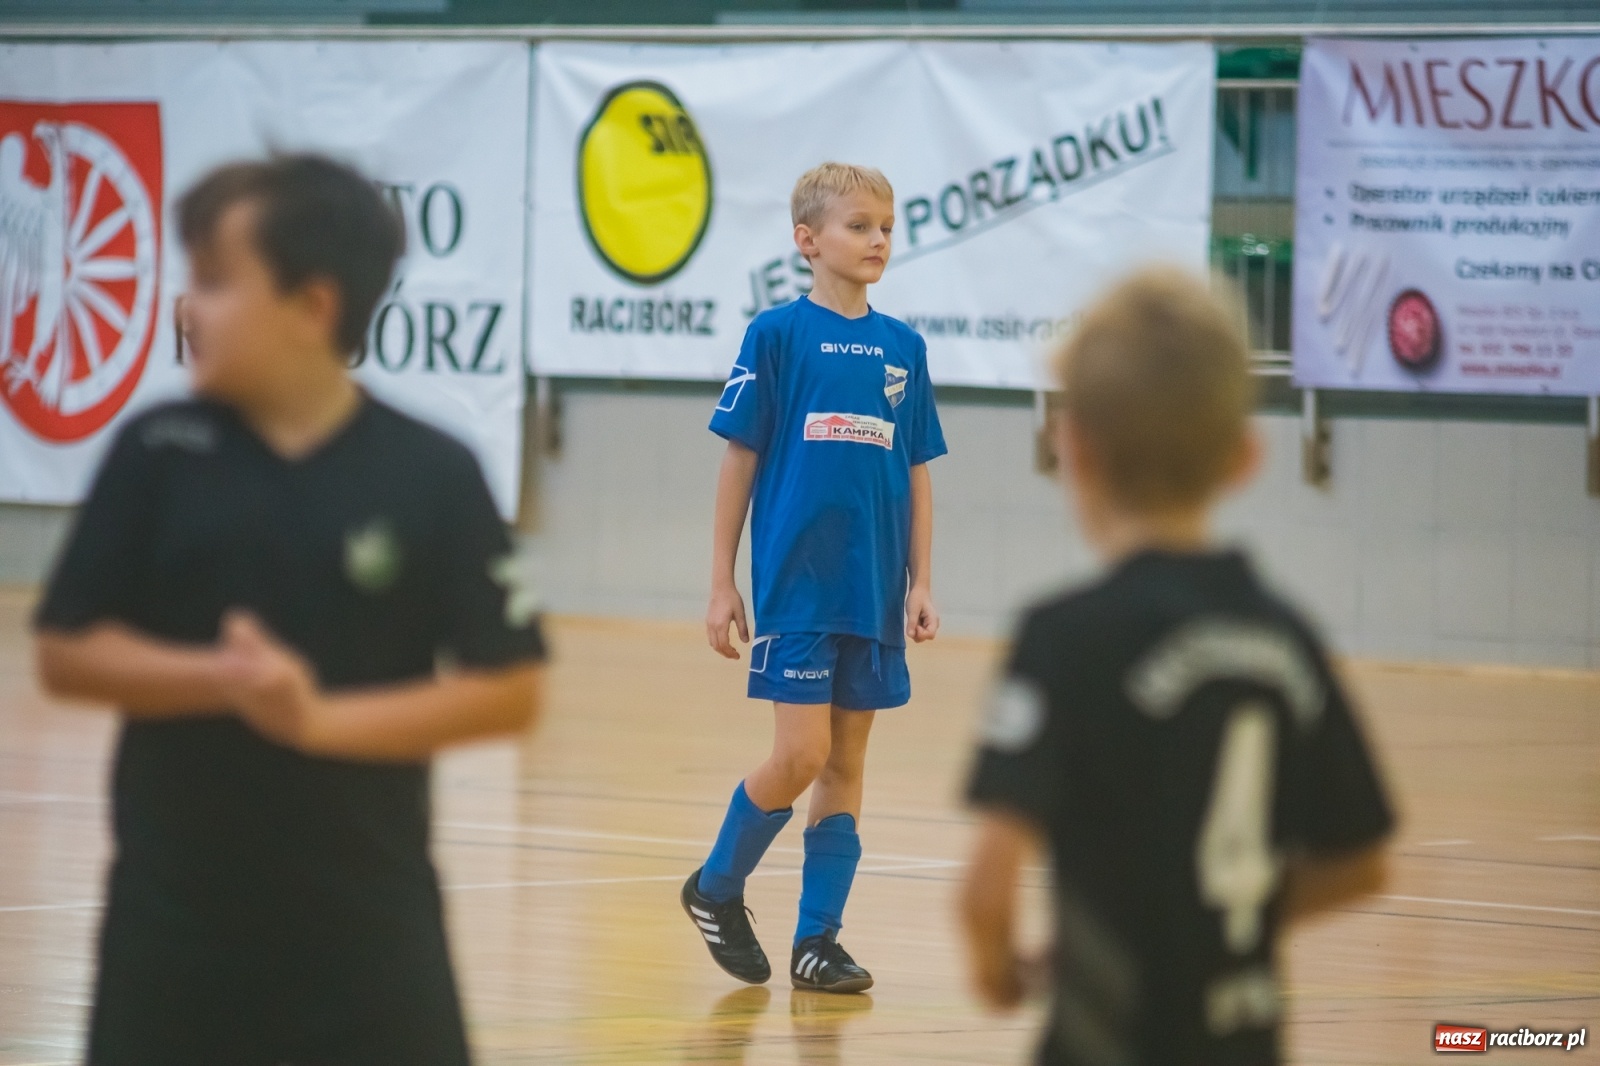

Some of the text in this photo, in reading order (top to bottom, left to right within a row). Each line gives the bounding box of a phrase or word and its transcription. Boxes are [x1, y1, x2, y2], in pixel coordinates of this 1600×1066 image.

[904, 97, 1168, 247] PORZĄDKU!
[1549, 262, 1575, 281] na
[743, 250, 814, 317] JES
[571, 291, 716, 335] RACIBÓRZ
[820, 342, 884, 359] GIVOVA
[833, 426, 885, 440] KAMPKA
[784, 669, 829, 679] GIVOVA
